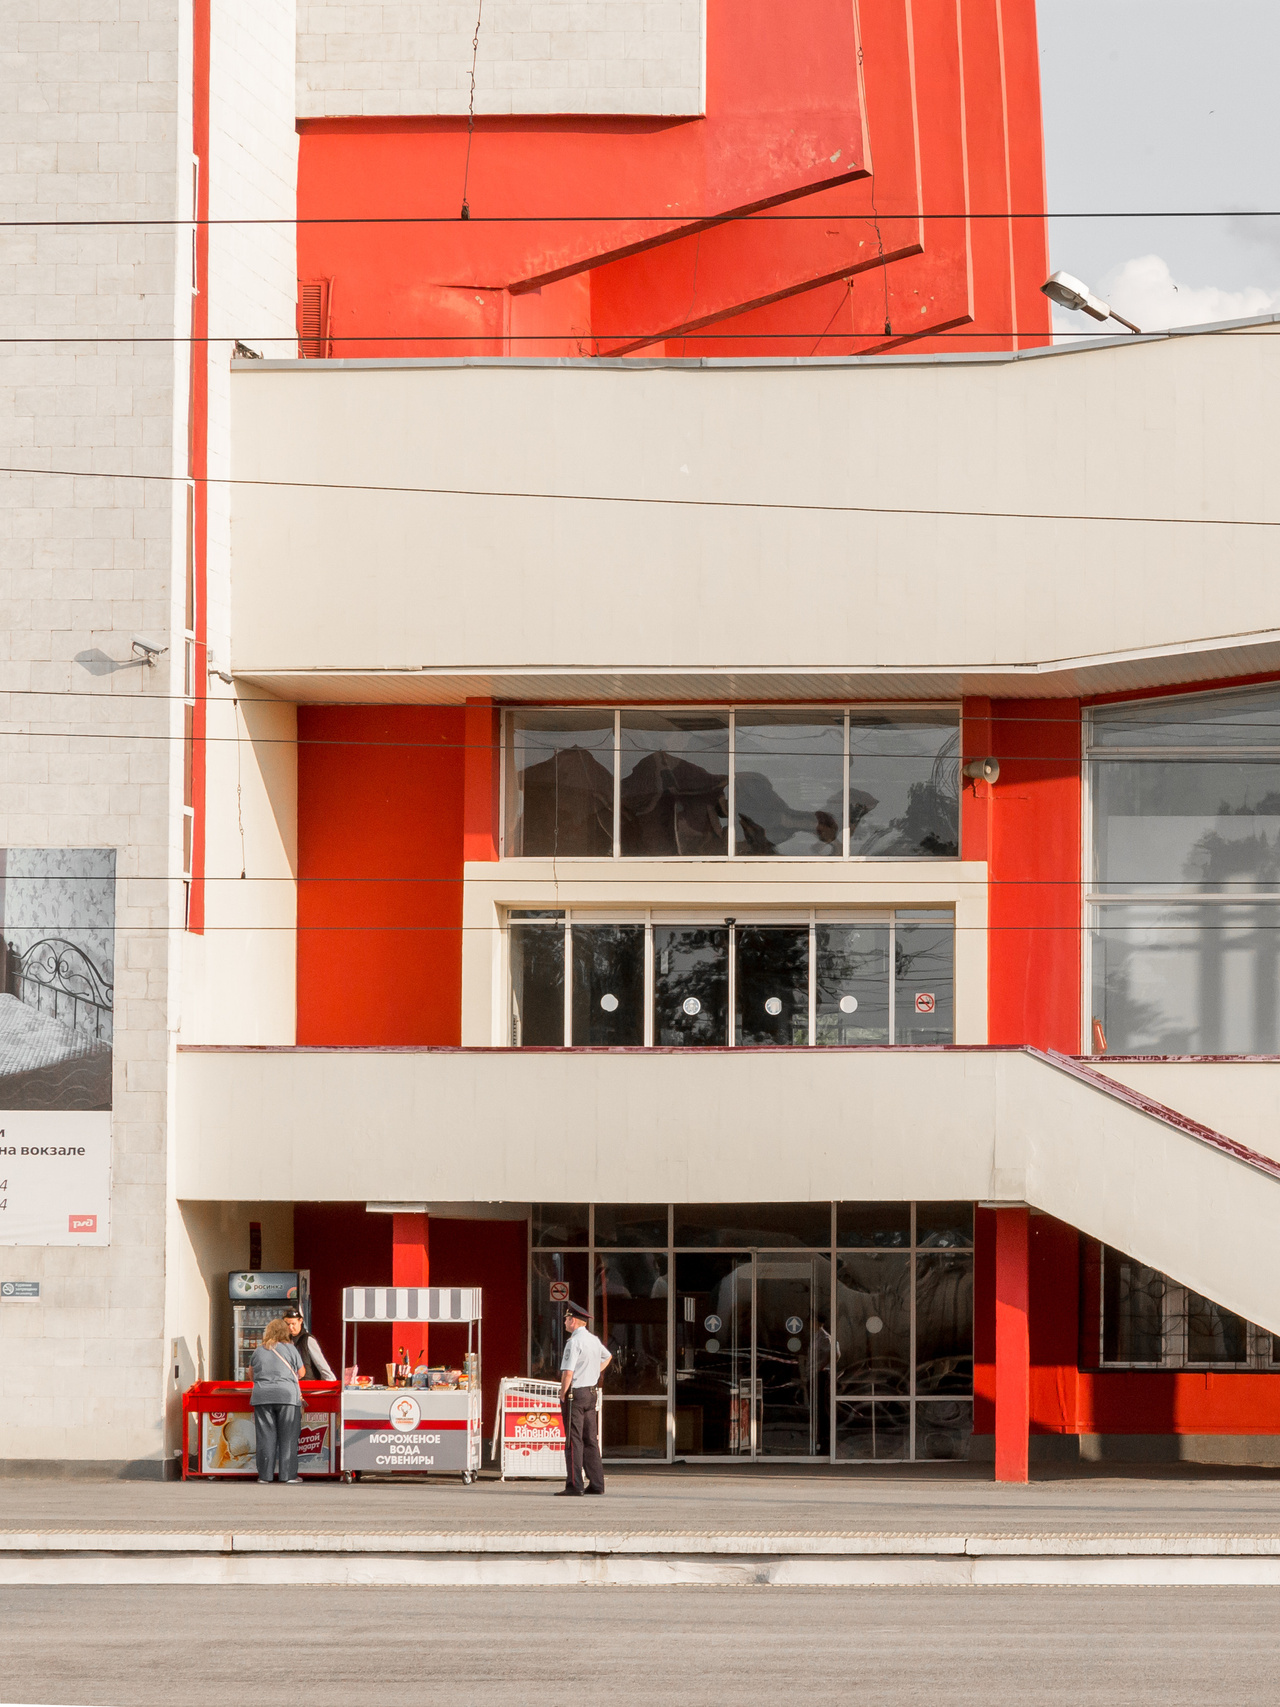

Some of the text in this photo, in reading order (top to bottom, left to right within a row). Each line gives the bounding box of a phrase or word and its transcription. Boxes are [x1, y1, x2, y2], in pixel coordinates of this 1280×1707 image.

[20, 1146, 86, 1156] вокзале
[369, 1434, 441, 1444] МОРОЖЕНОЕ
[389, 1445, 420, 1455] ВОДА
[375, 1455, 434, 1465] СУВЕНИРЫ
